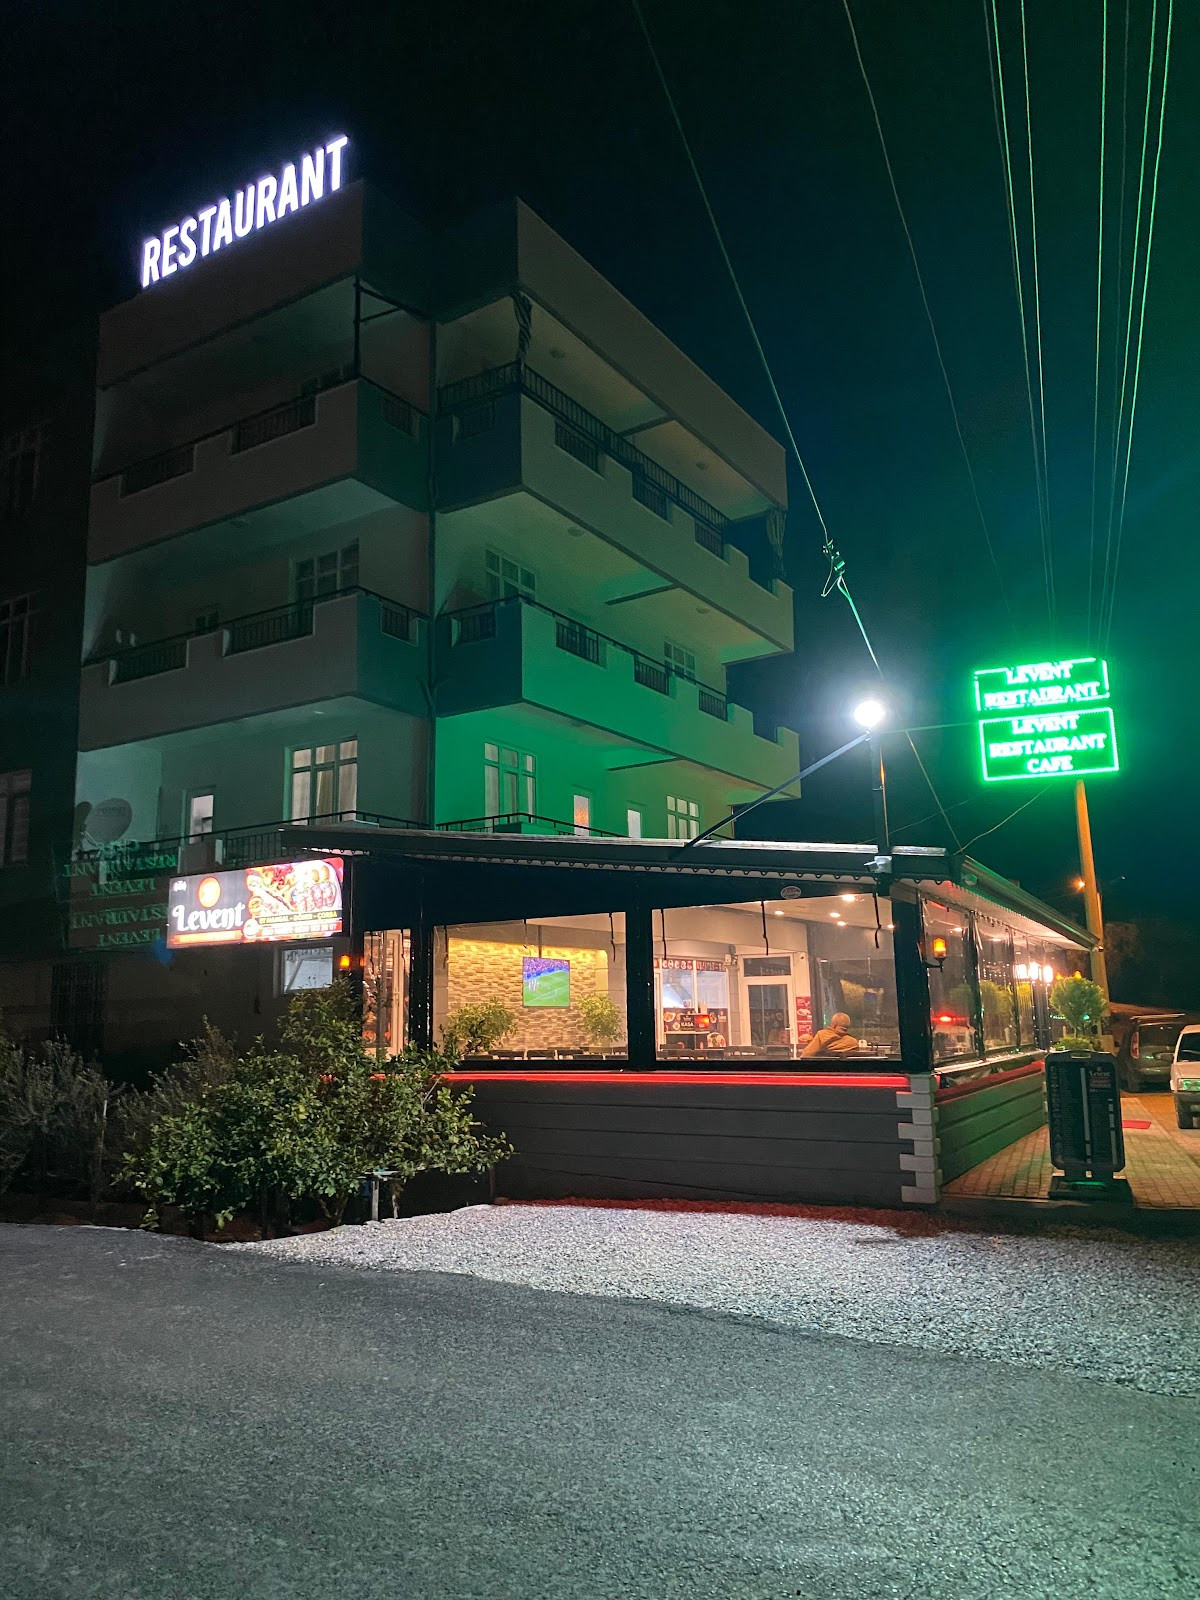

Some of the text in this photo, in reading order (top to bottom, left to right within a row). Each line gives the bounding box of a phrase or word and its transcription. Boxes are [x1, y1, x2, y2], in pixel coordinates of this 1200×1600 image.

[140, 134, 348, 288] RESTAURANT
[1006, 662, 1073, 684] LEVENT
[984, 682, 1100, 706] RESTAURANT
[1012, 713, 1079, 734] LEVENT
[989, 734, 1106, 758] RESTAURANT
[1027, 756, 1073, 773] CAFE
[172, 902, 246, 932] Levent
